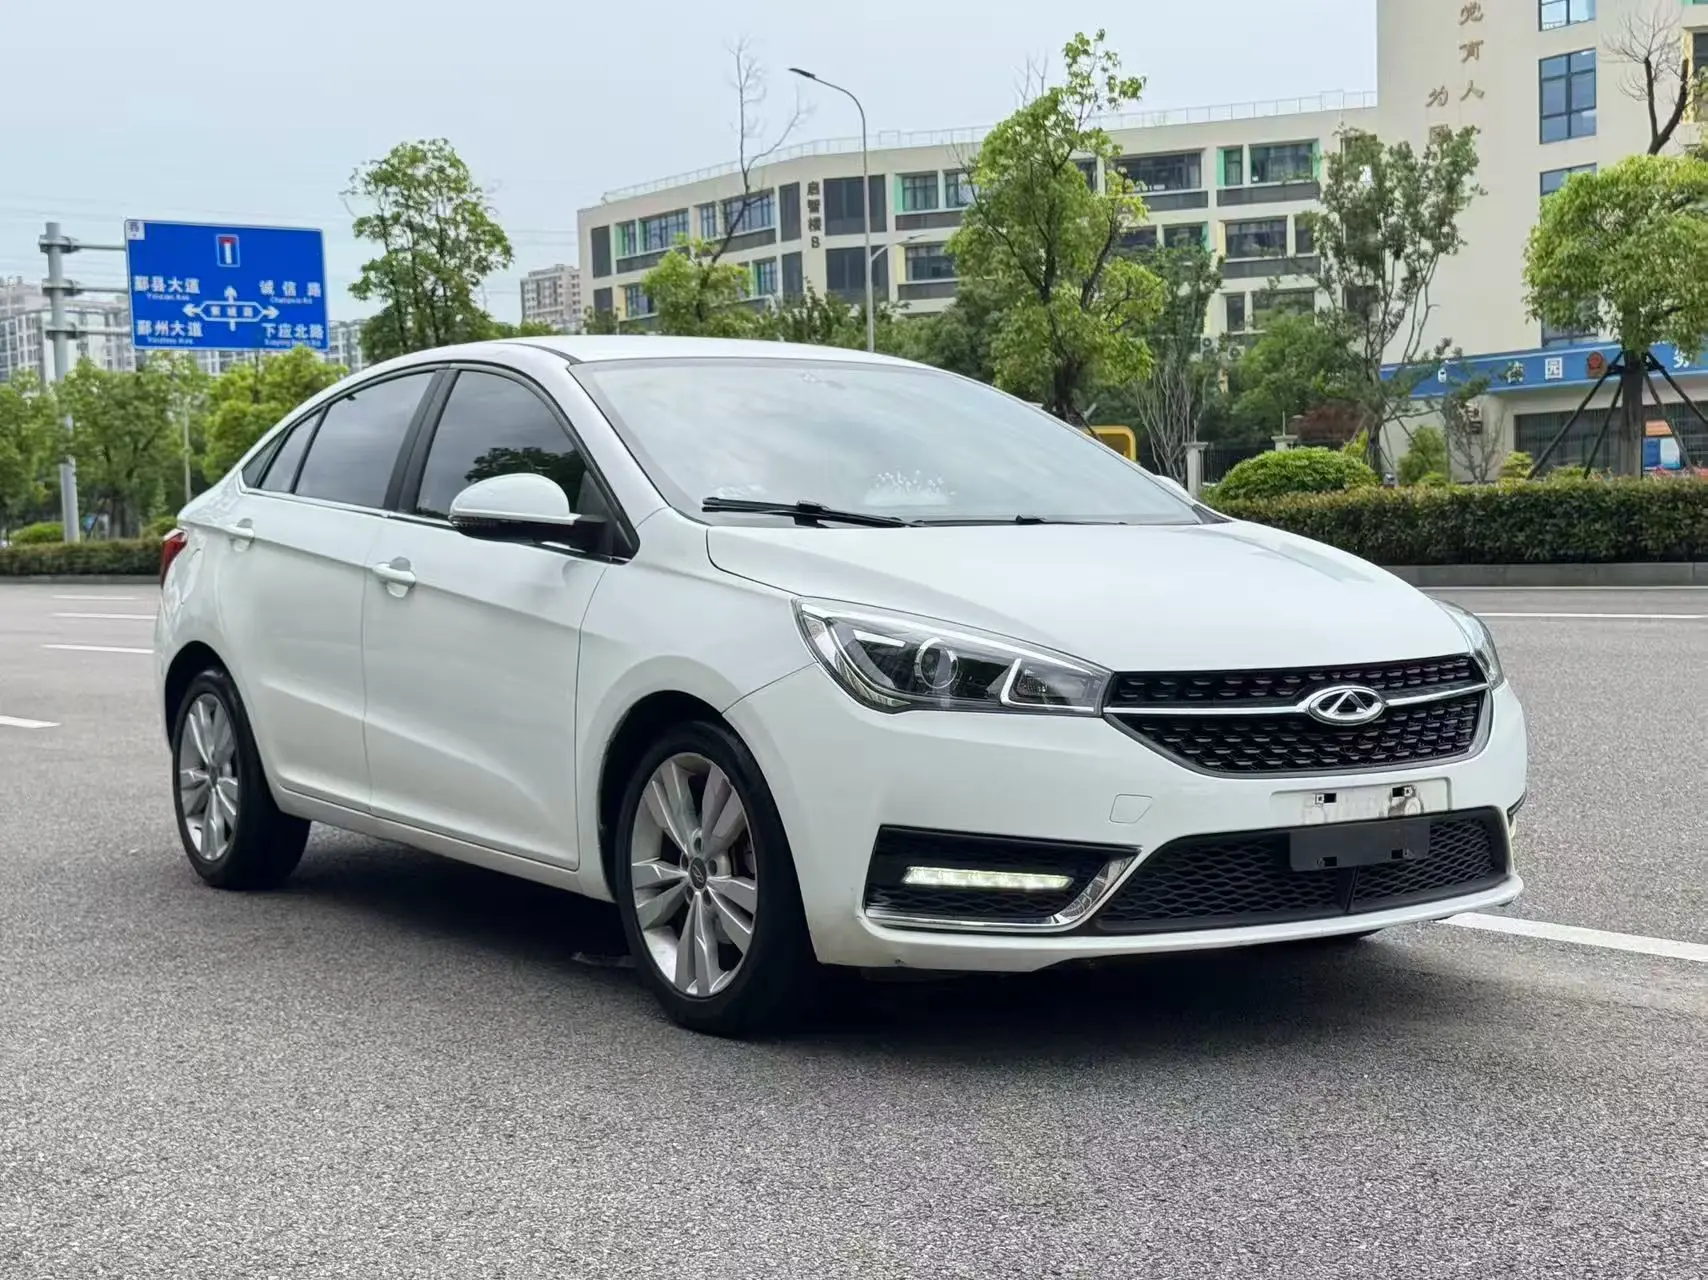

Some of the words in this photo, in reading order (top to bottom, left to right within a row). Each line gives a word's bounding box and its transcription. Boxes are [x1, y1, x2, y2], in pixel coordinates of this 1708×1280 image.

[134, 275, 200, 294] 鄞县大道
[259, 280, 321, 297] 诚信路
[136, 319, 204, 338] 鄞州大道
[261, 322, 324, 340] 下应北路
